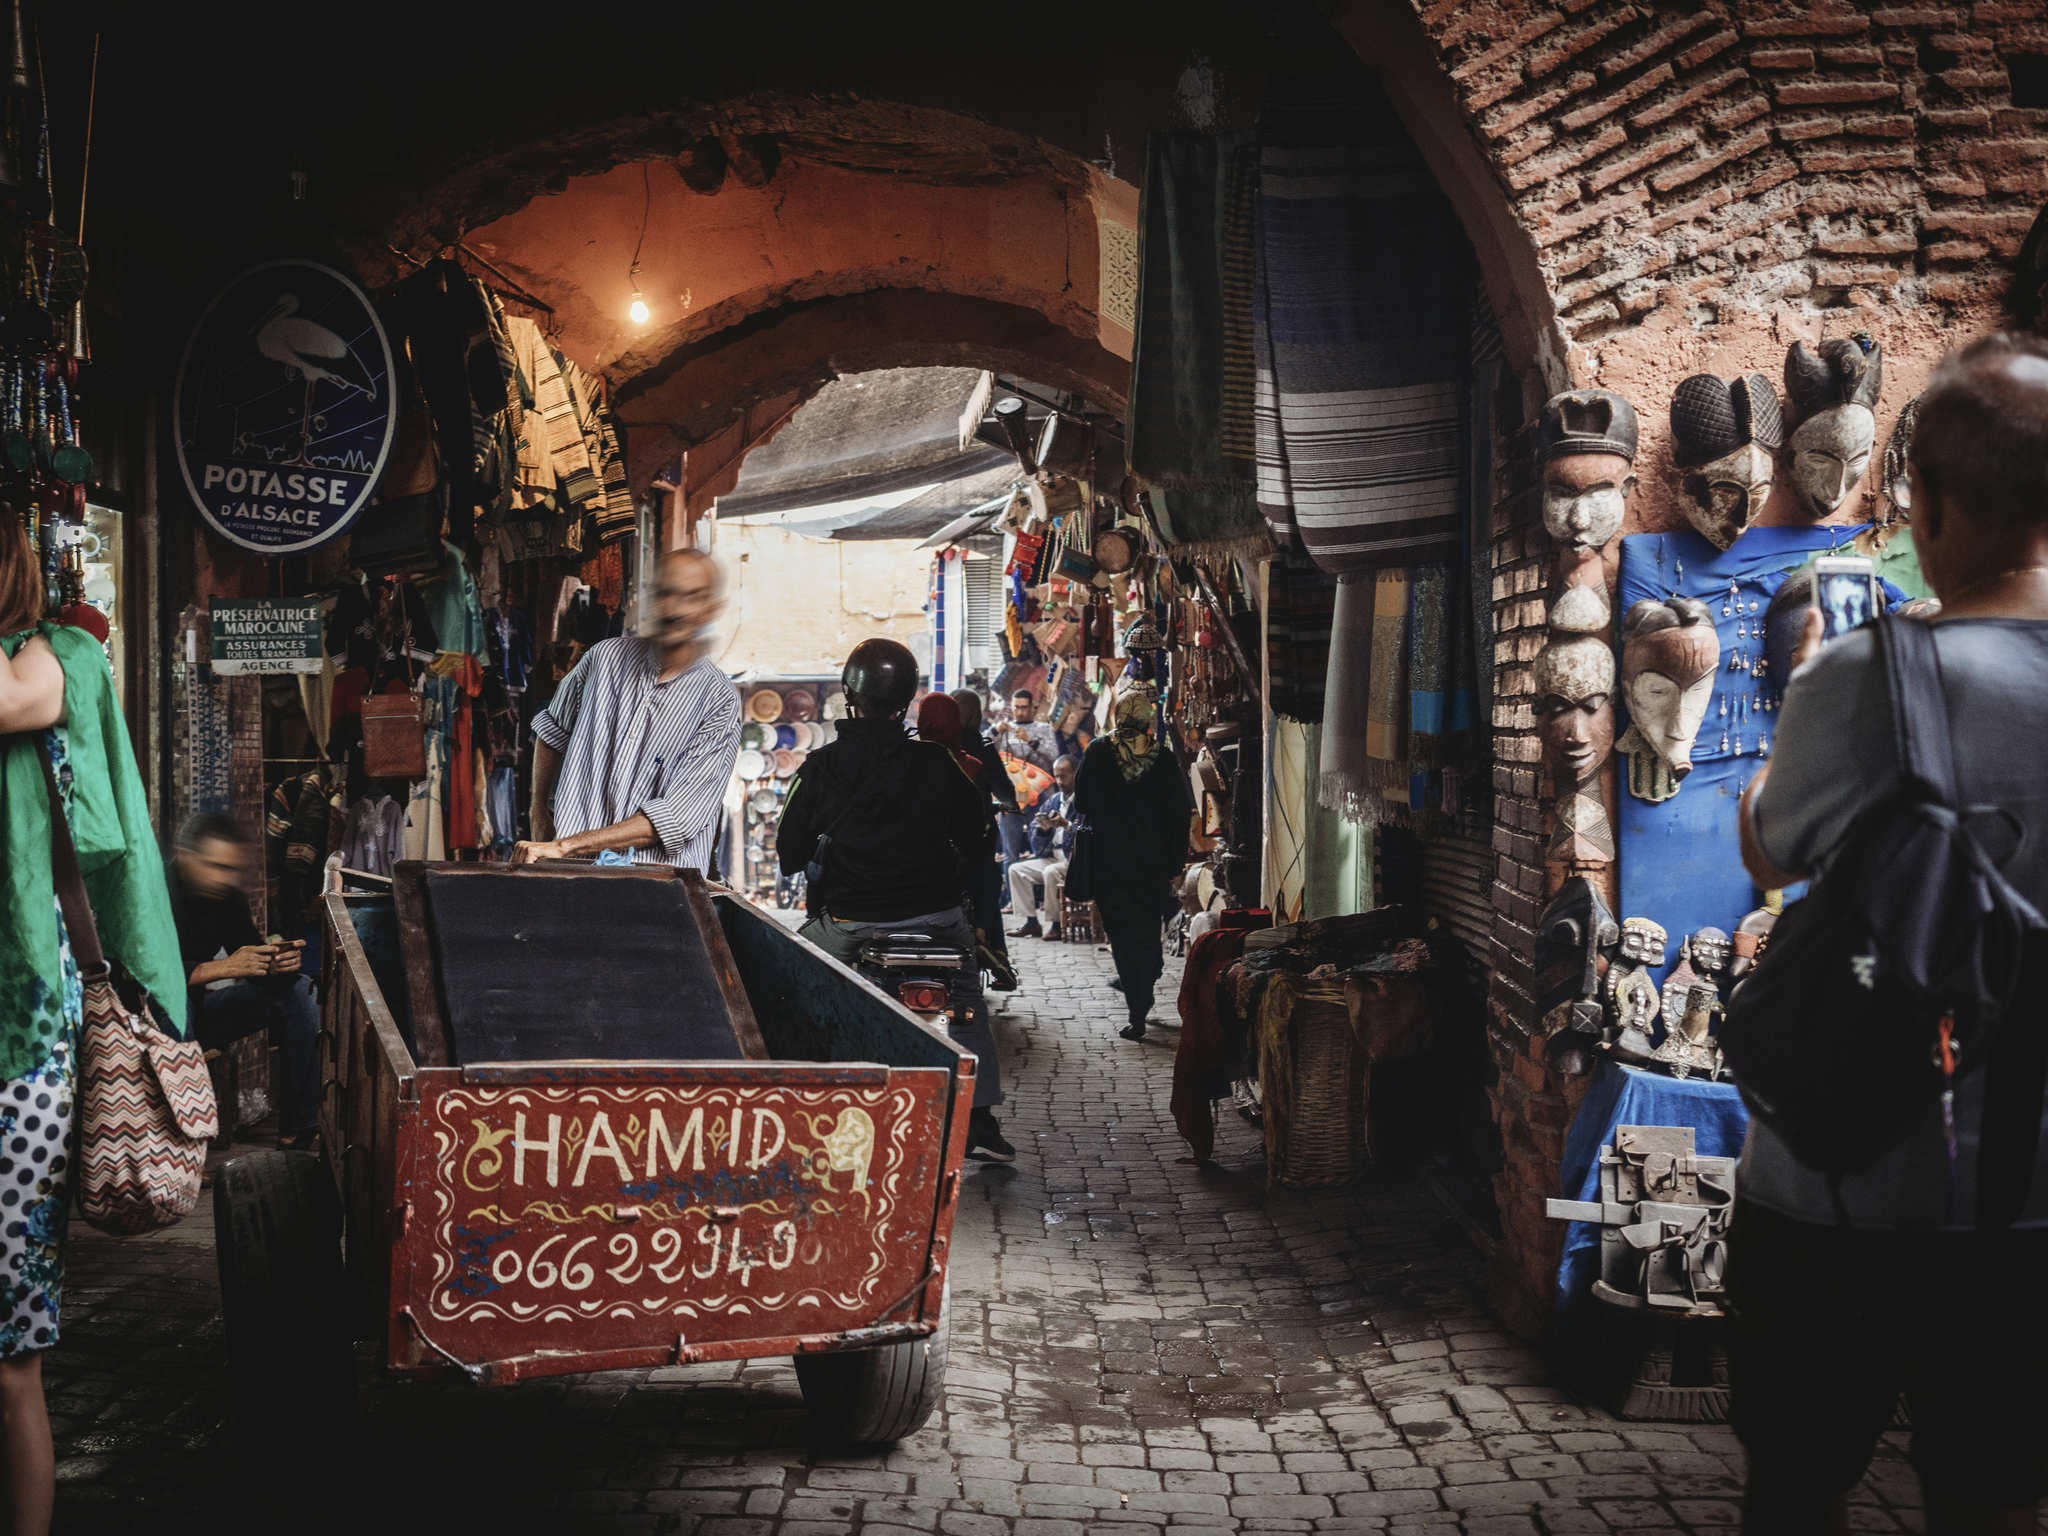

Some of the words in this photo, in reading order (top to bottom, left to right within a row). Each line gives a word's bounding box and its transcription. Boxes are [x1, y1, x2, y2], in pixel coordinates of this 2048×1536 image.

[203, 464, 348, 506] POTASSE
[220, 501, 321, 527] D'ALSACE
[257, 600, 272, 609] LA
[224, 621, 307, 634] MAROCAINE
[225, 640, 307, 650] ASSURANCES
[226, 650, 259, 659] TOUTES
[262, 649, 307, 658] BRANCHES
[241, 661, 294, 671] AGENCE
[513, 1097, 786, 1188] HAMID
